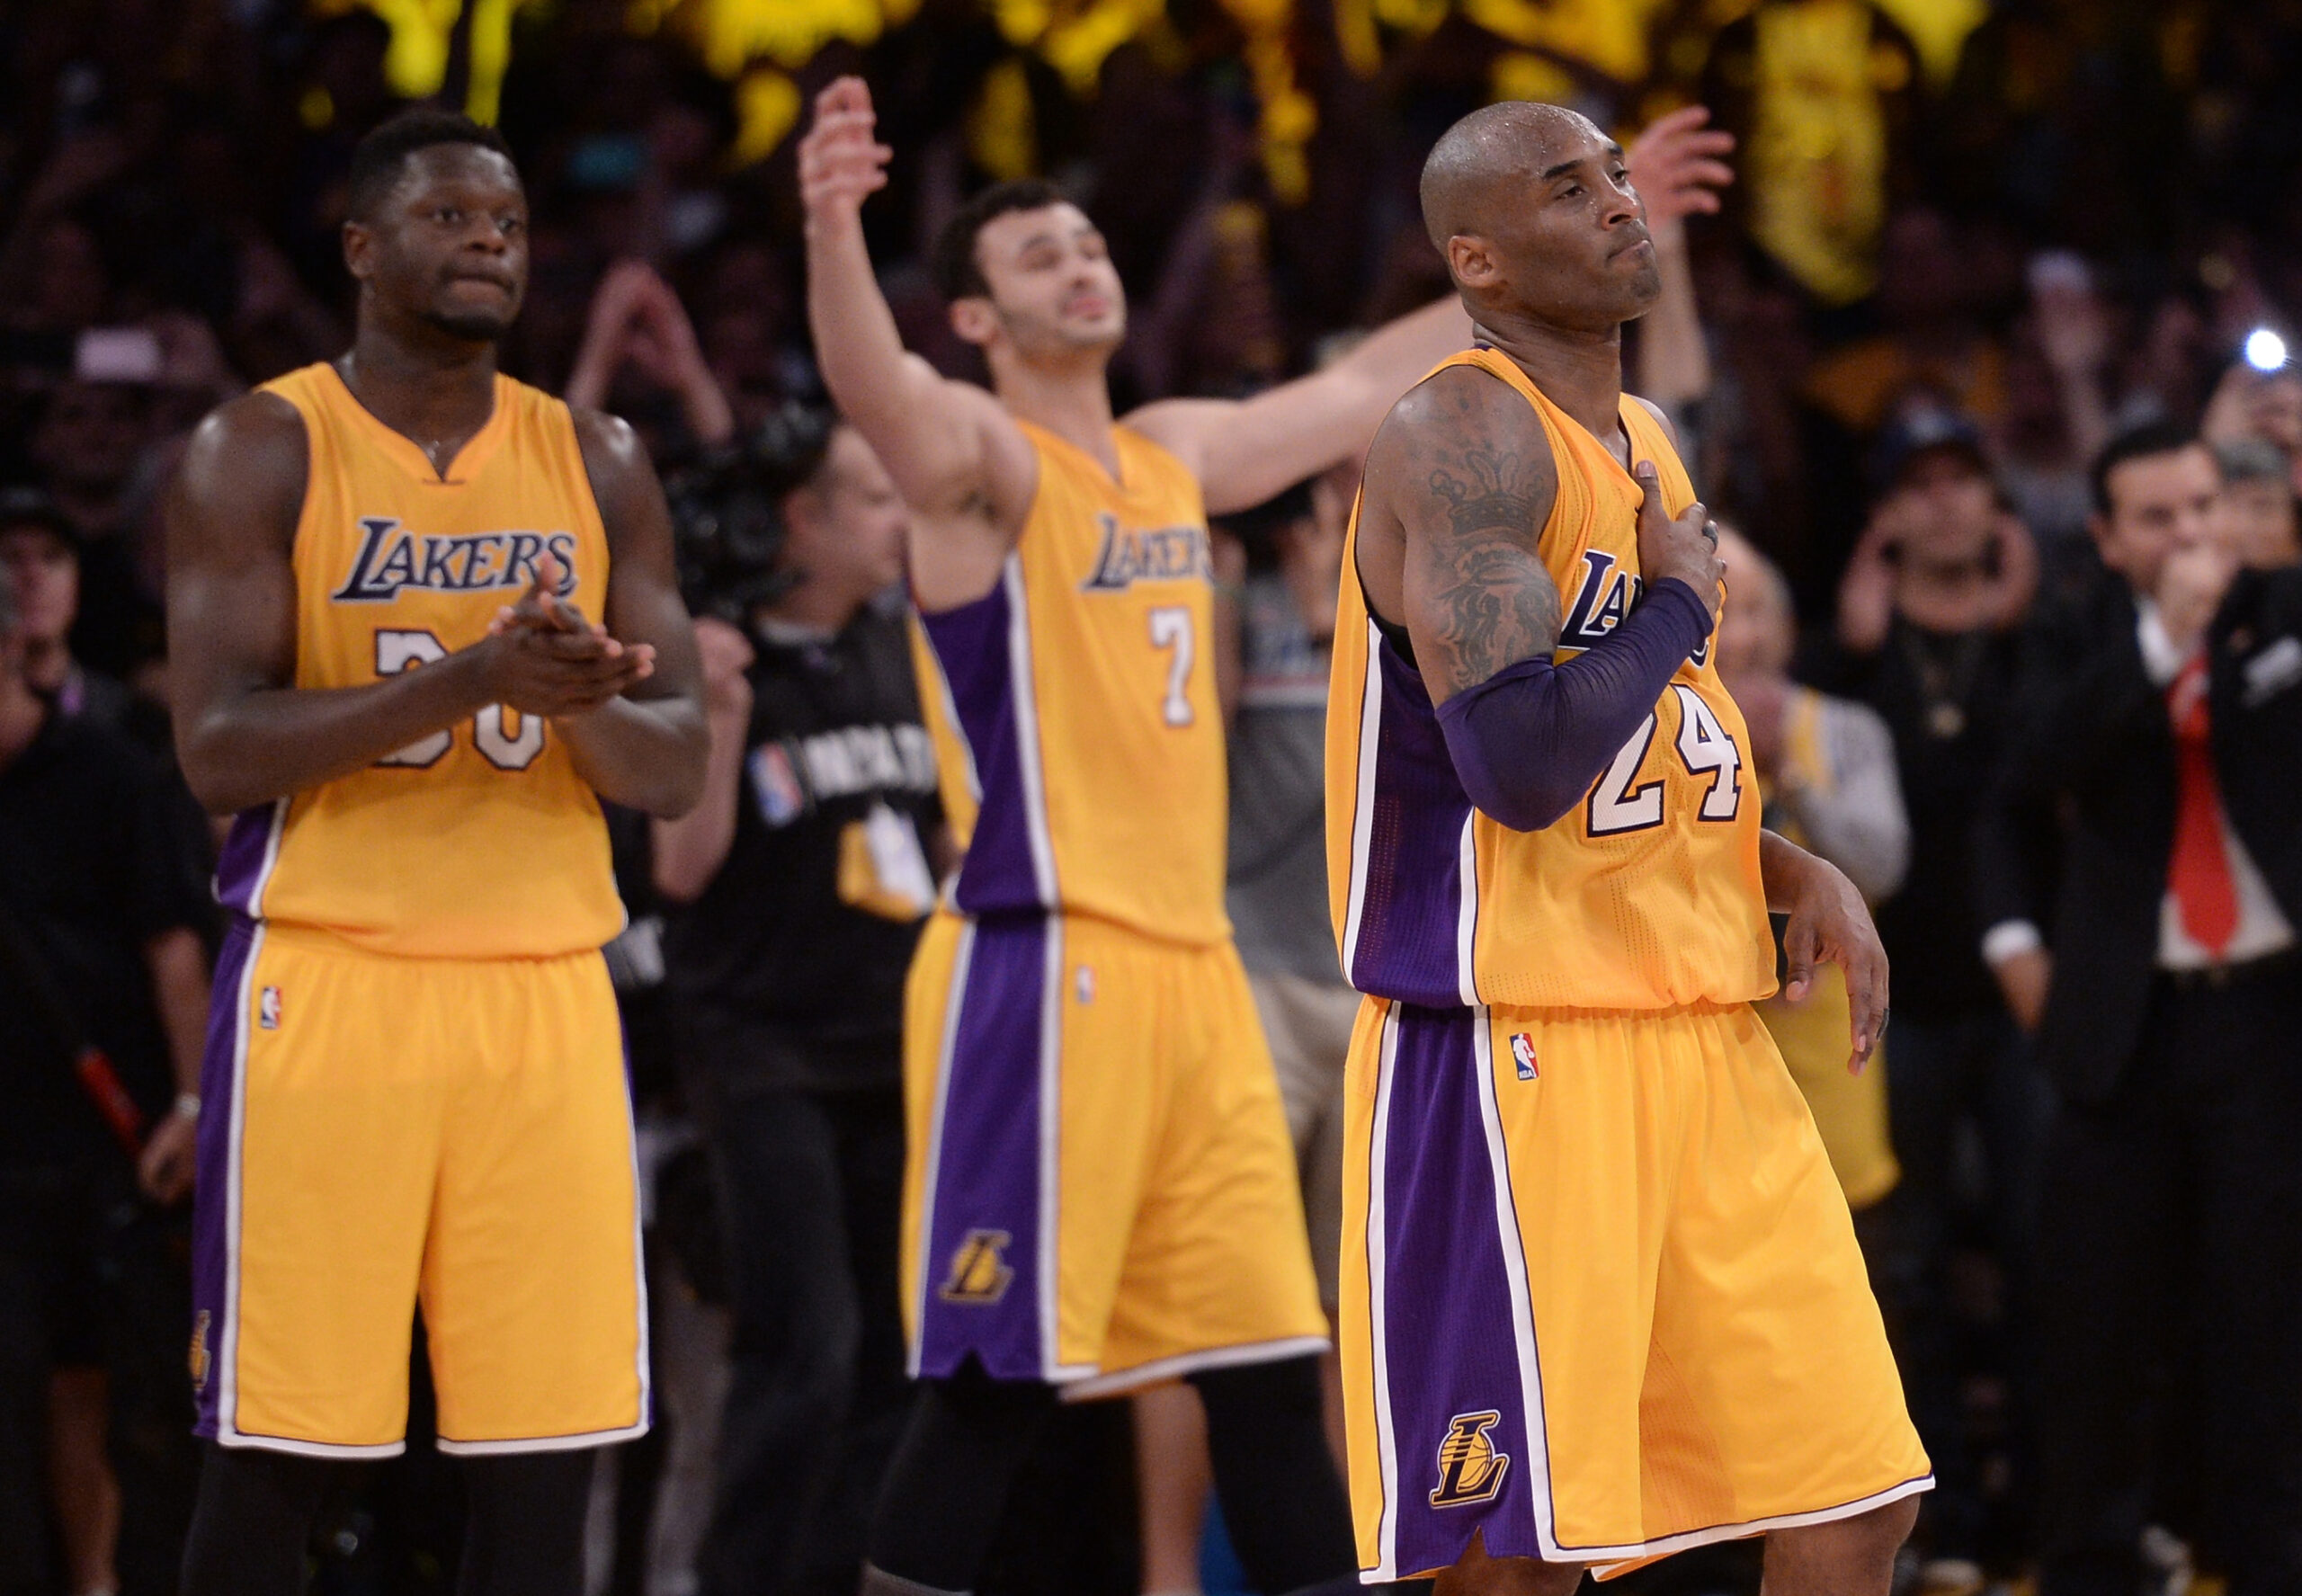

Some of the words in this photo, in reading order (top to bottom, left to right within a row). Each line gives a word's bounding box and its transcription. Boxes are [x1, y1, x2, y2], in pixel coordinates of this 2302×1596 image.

[330, 516, 579, 604] LAKERS
[1148, 606, 1194, 727] 7
[1587, 682, 1742, 838] 24
